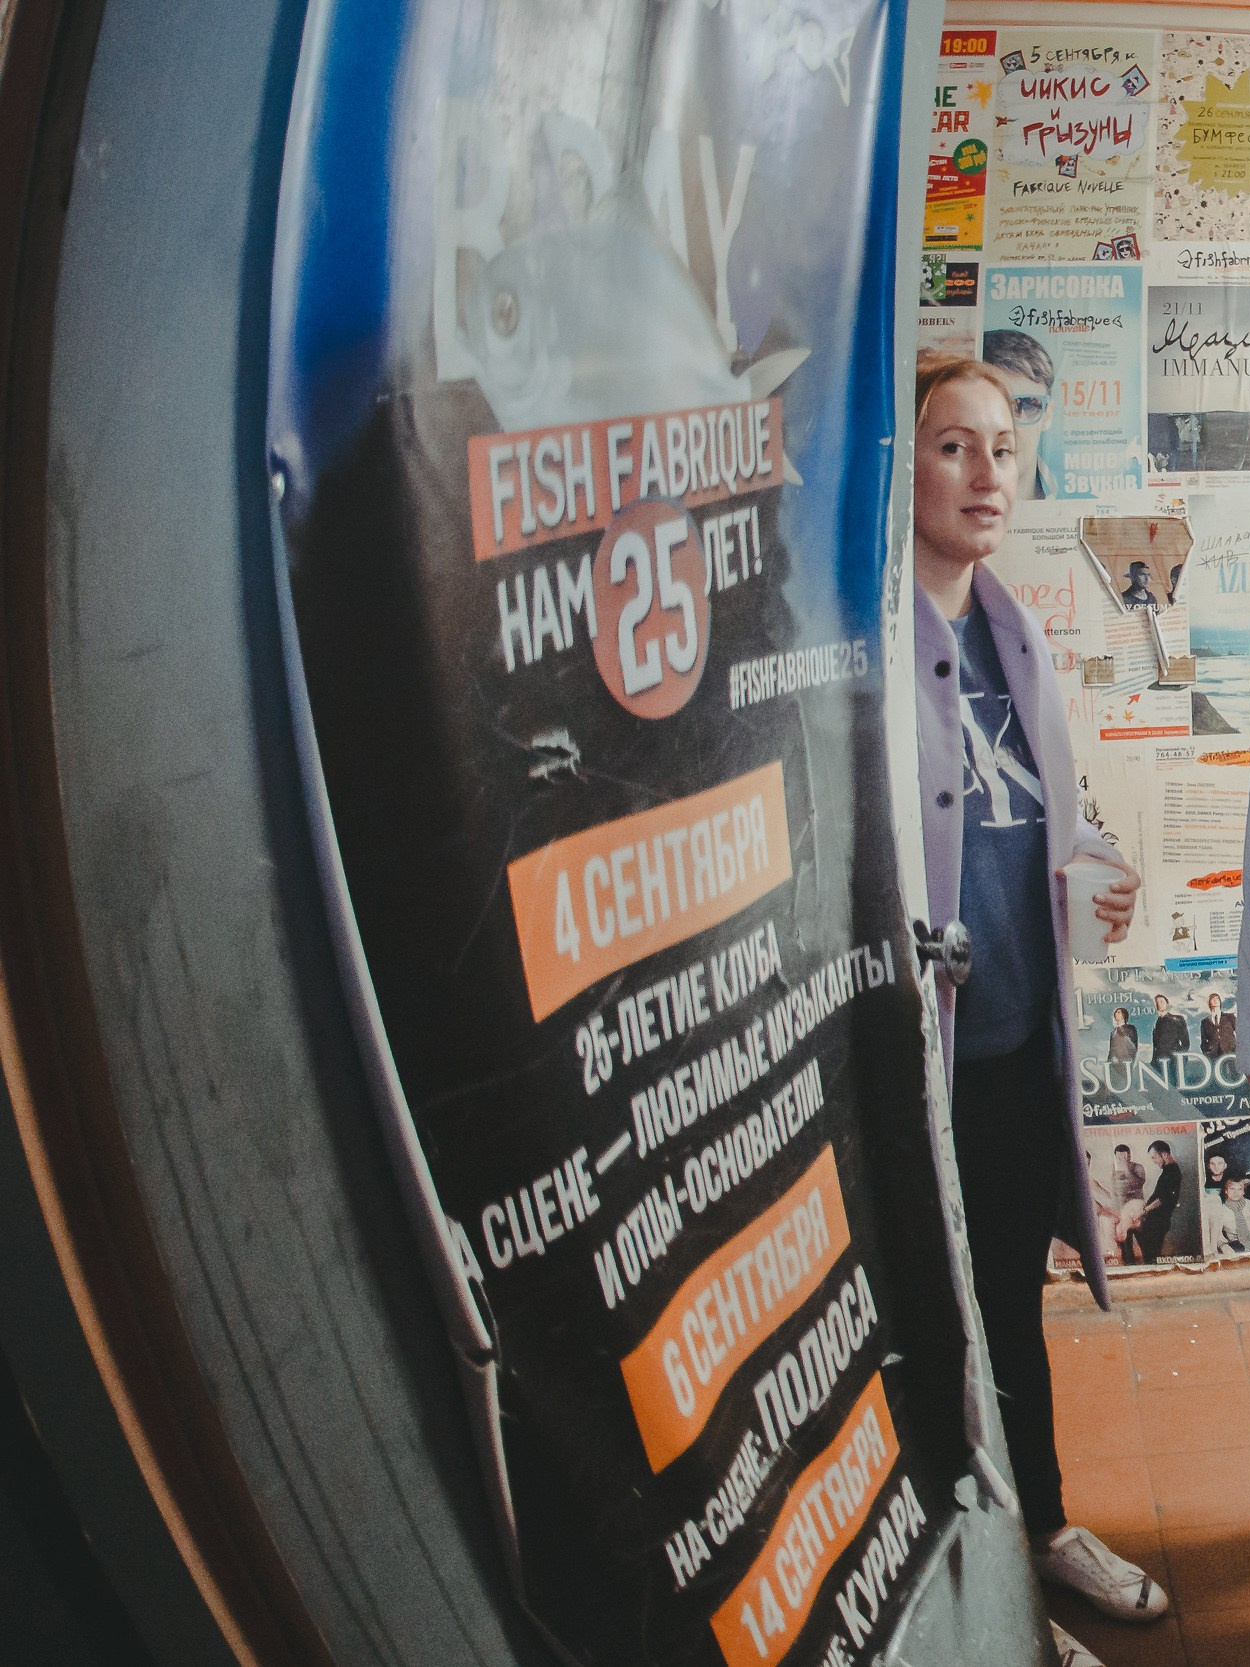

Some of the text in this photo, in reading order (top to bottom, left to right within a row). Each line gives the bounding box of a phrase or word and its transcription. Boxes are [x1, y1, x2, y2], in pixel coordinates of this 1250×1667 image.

[943, 38, 988, 53] 19:00
[1030, 46, 1041, 63] 5
[1046, 47, 1120, 64] СЕНТЯБРЯ
[1020, 76, 1111, 101] ЧИКИС
[1197, 106, 1213, 118] 26
[931, 110, 970, 133] AR
[1023, 113, 1132, 157] ГРЫЗУНЫ
[1162, 302, 1203, 315] 21/11
[1061, 379, 1121, 410] 15/11
[489, 402, 773, 546] FISH FABRIQUE
[496, 505, 763, 698] НАМ 25 ЛЕТ!
[728, 639, 869, 711] #FISHFABRIQUE25
[1078, 775, 1089, 791] 4
[554, 794, 771, 964] 4 СЕНТЯБРЯ
[574, 919, 783, 1097] 25-ЛЕТИЕ КЛУБА
[480, 1145, 602, 1271] СЦЕНЕ
[629, 1014, 774, 1160] ЛЮБИМЫЕ
[766, 938, 898, 1066] МУЗЫКАНТЫ
[1180, 1094, 1223, 1106] SUPPORT
[1083, 1126, 1133, 1138] ЕНТАЦИЯ
[592, 1058, 826, 1310] И ОТЦЫ-ОСНОВАТЕЛИ!
[660, 1185, 831, 1420] 6 СЕНТЯБРЯ
[664, 1263, 880, 1590] НА СЦЕНЕ: ПОЛЮСА
[738, 1404, 888, 1659] 14 СЕНТЯБРЯ
[835, 1474, 927, 1650] КУРАРА
